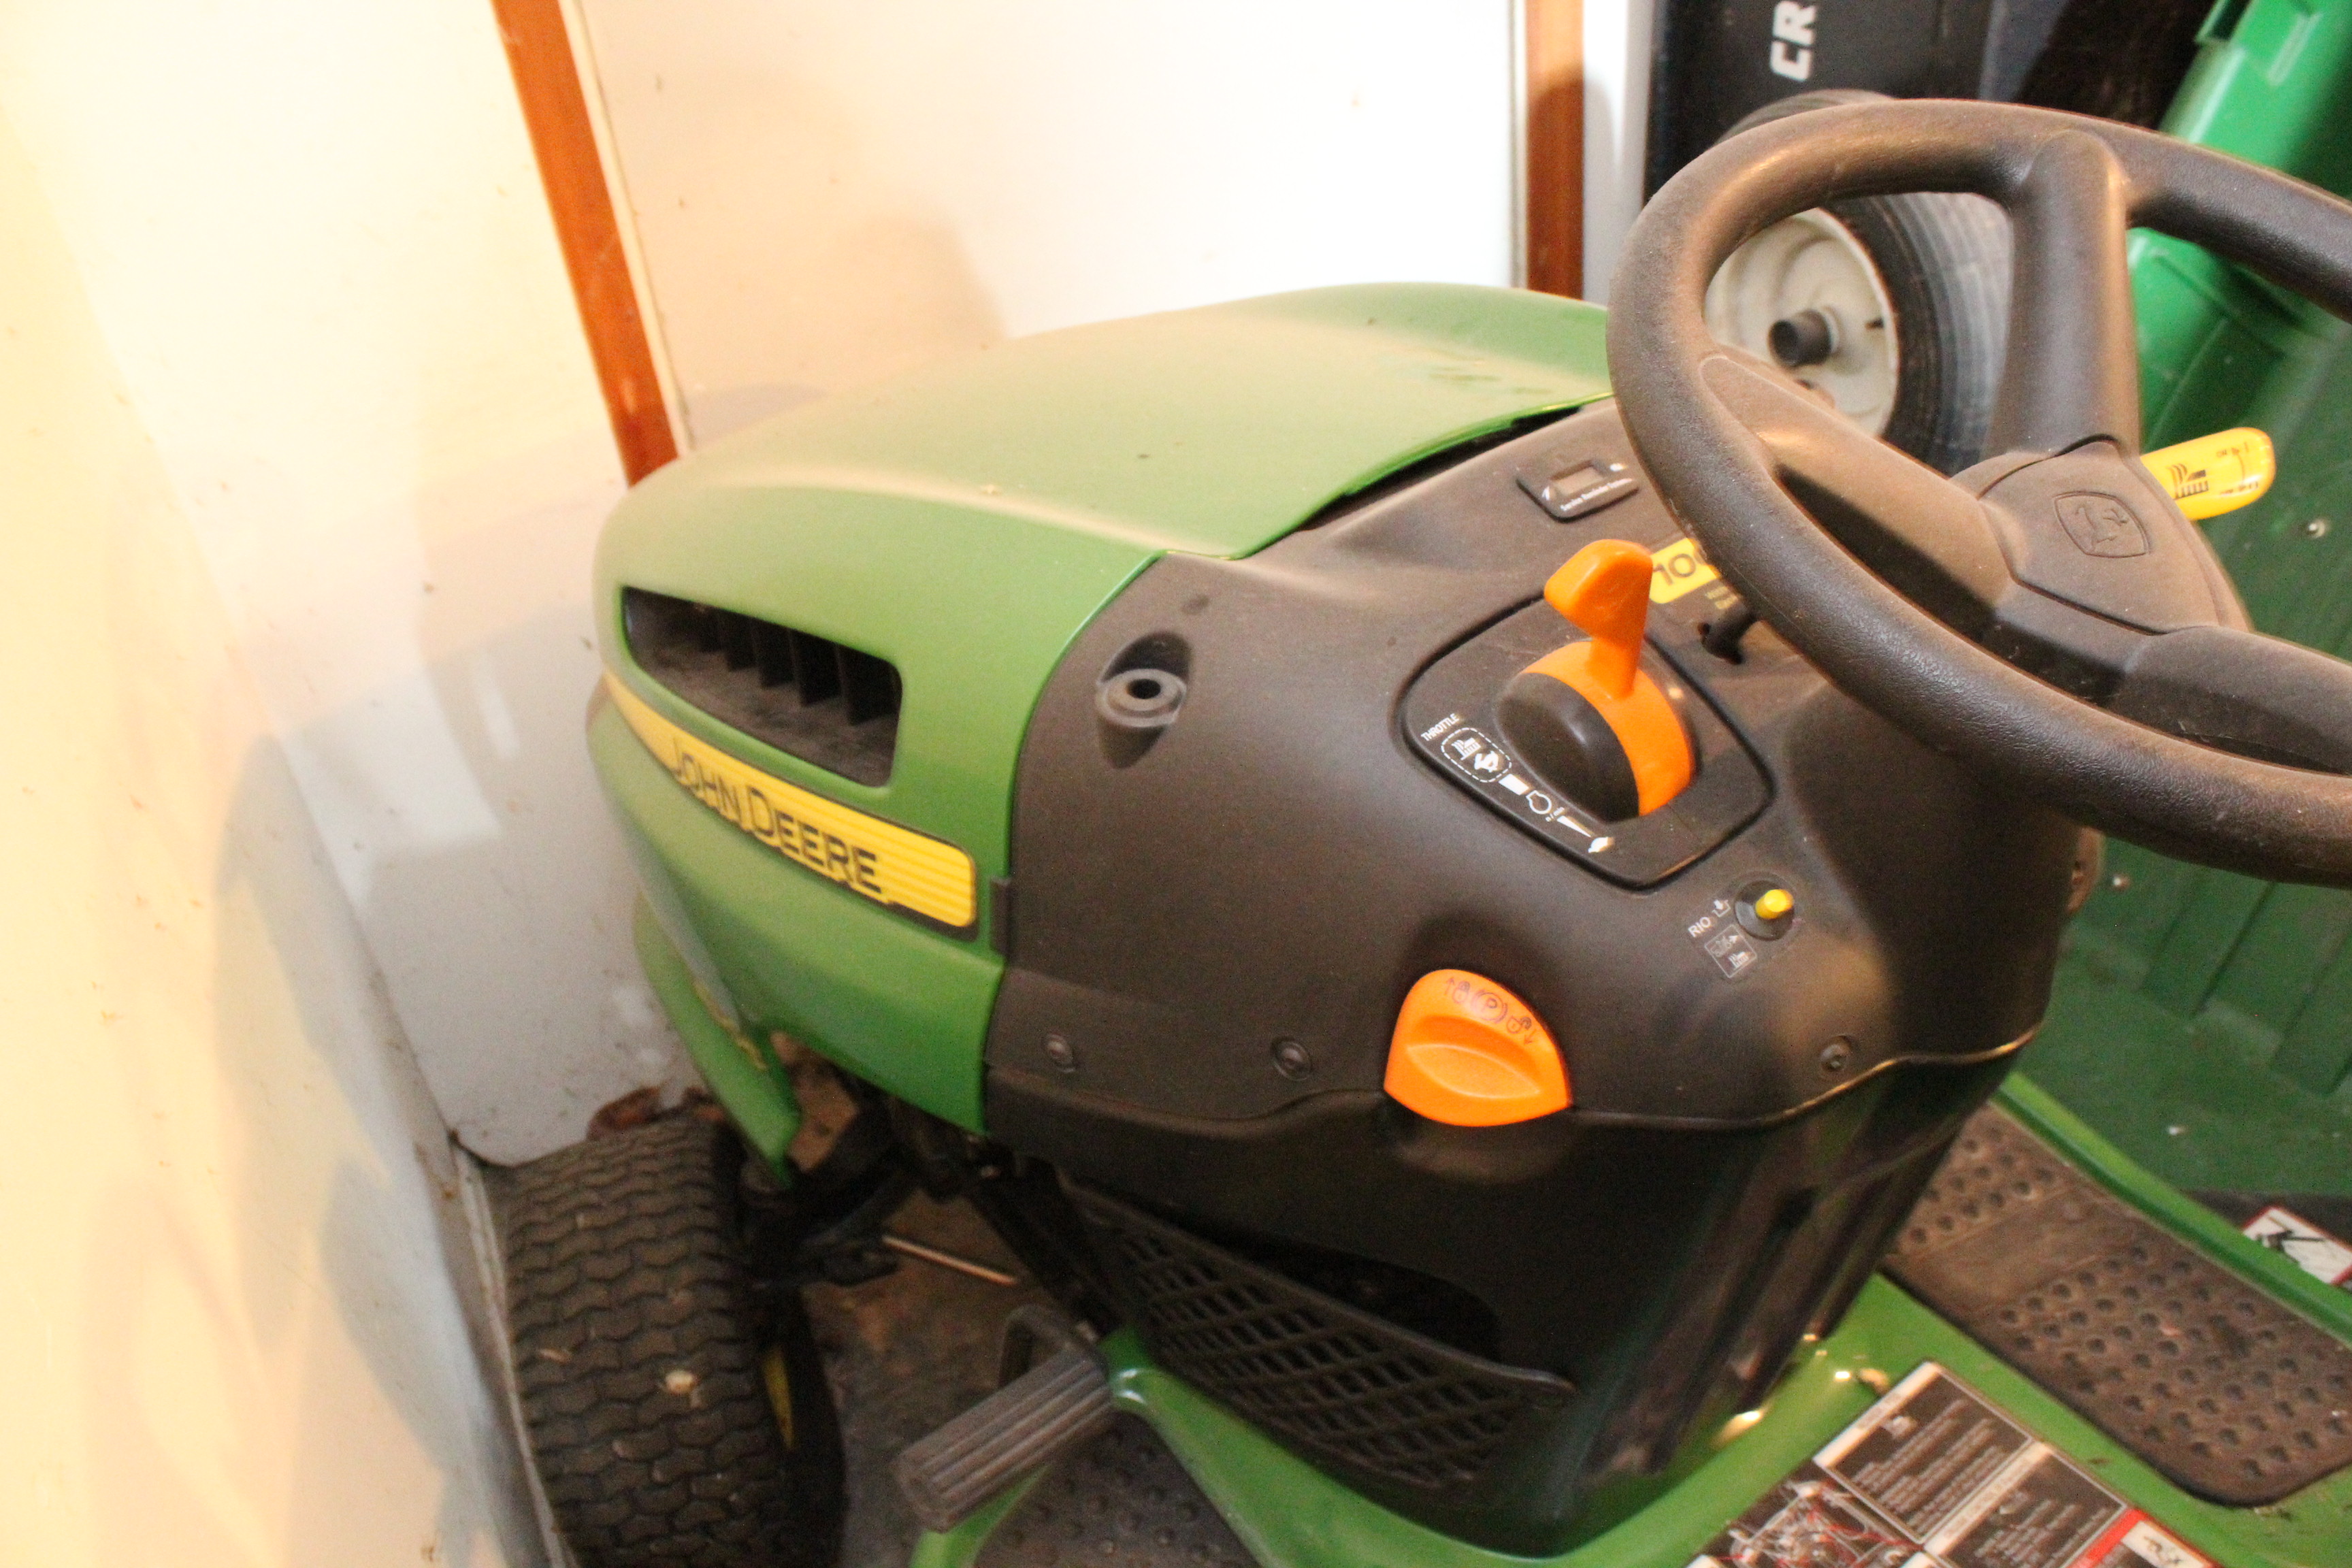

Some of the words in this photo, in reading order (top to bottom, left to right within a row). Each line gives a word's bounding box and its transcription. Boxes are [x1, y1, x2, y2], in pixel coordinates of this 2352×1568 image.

[1652, 545, 1707, 587] 10
[1420, 713, 1460, 742] THROTTLE
[671, 736, 743, 826] JOHN
[745, 783, 884, 896] DEERE
[1687, 916, 1712, 938] RIO
